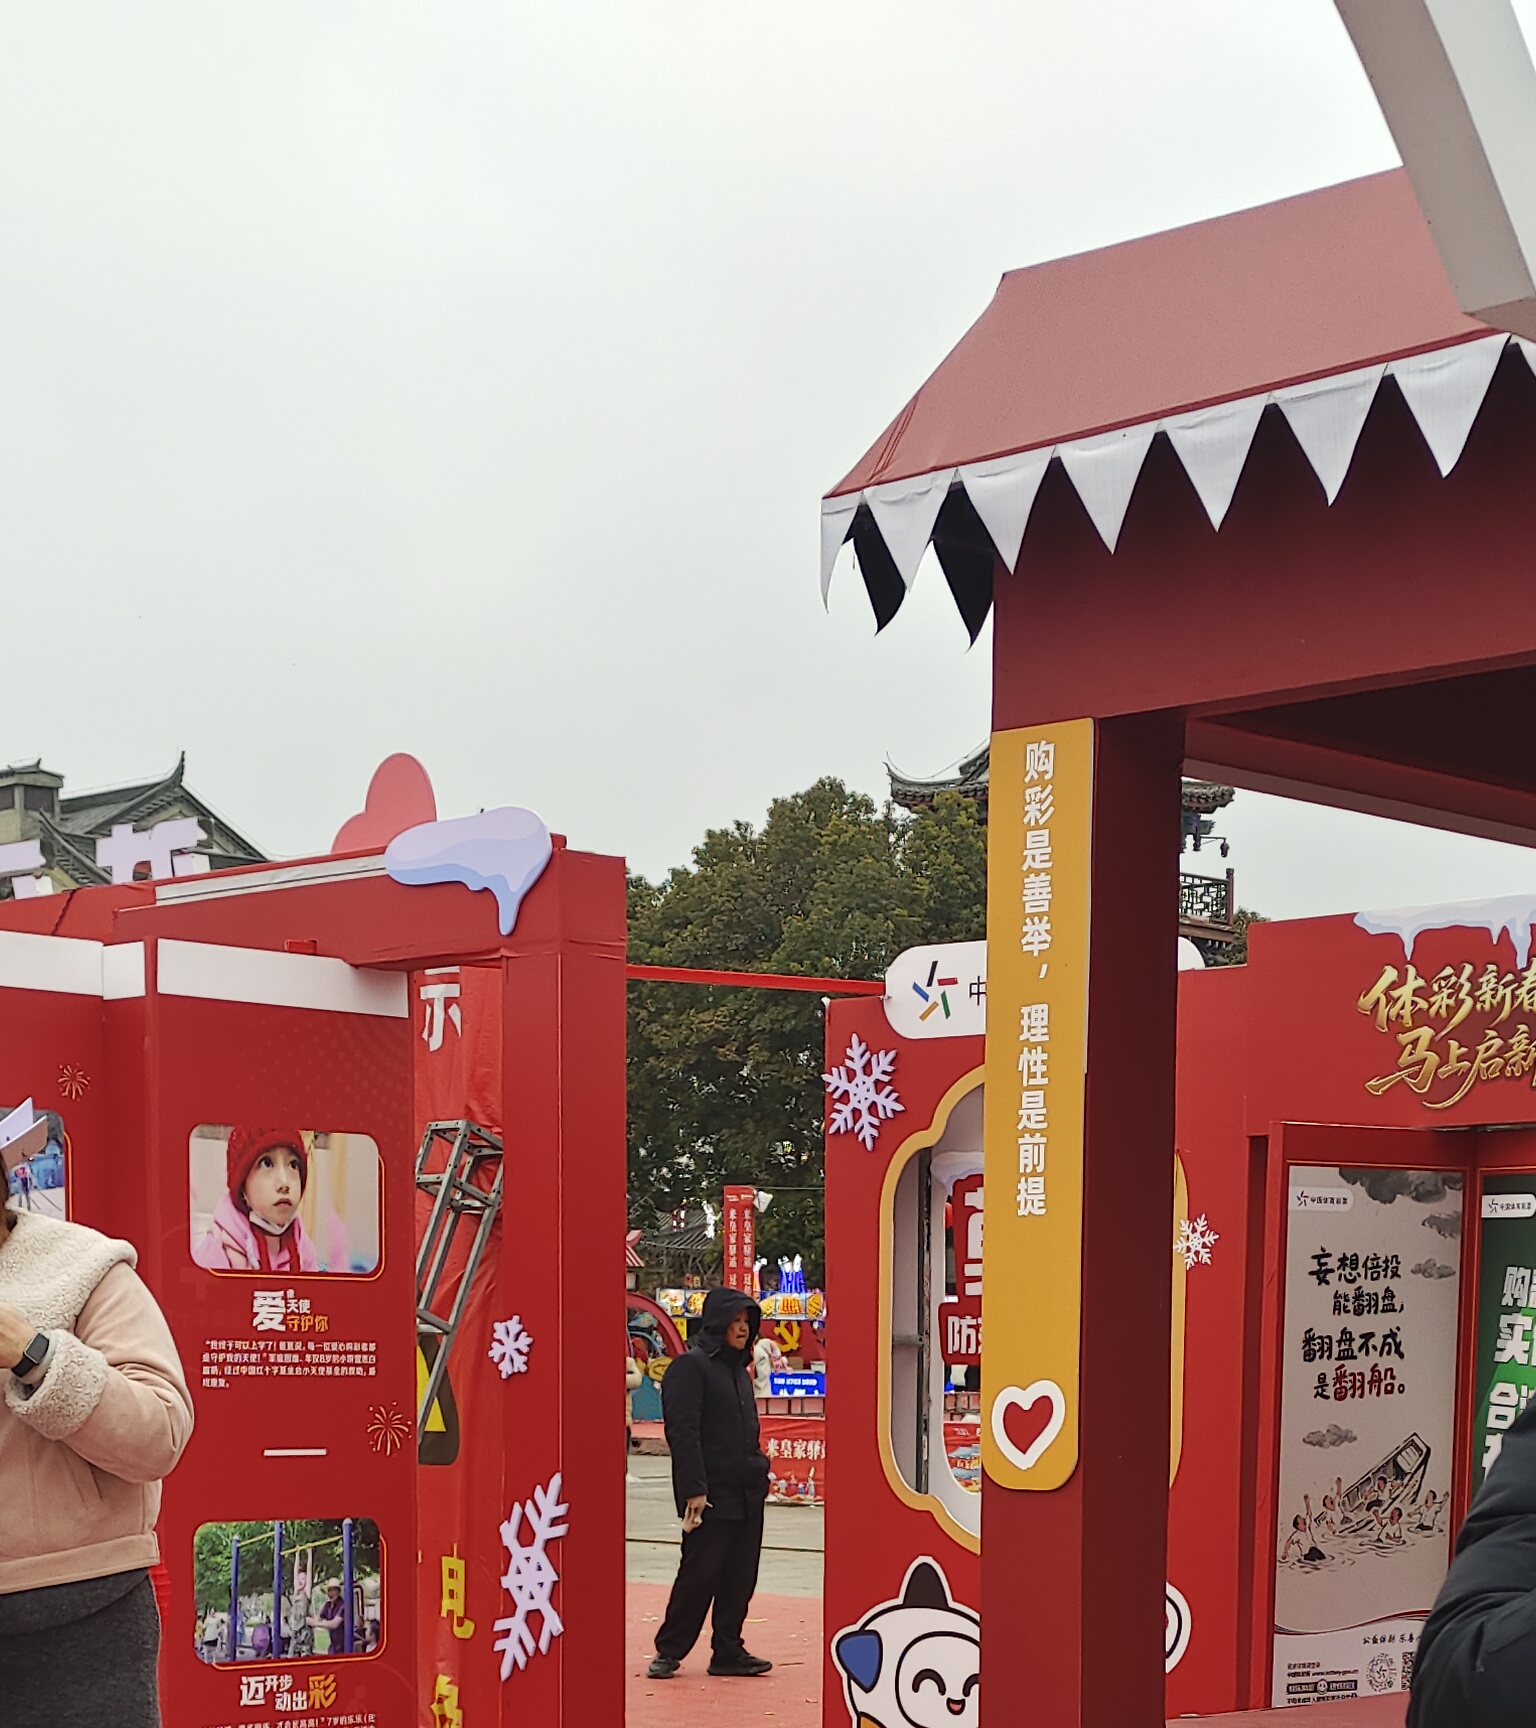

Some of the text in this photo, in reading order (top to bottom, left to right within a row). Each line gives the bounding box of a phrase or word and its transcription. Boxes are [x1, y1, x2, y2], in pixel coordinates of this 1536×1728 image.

[1308, 1247, 1402, 1285] 妄想倍投
[1301, 1326, 1405, 1362] 翻盘不成
